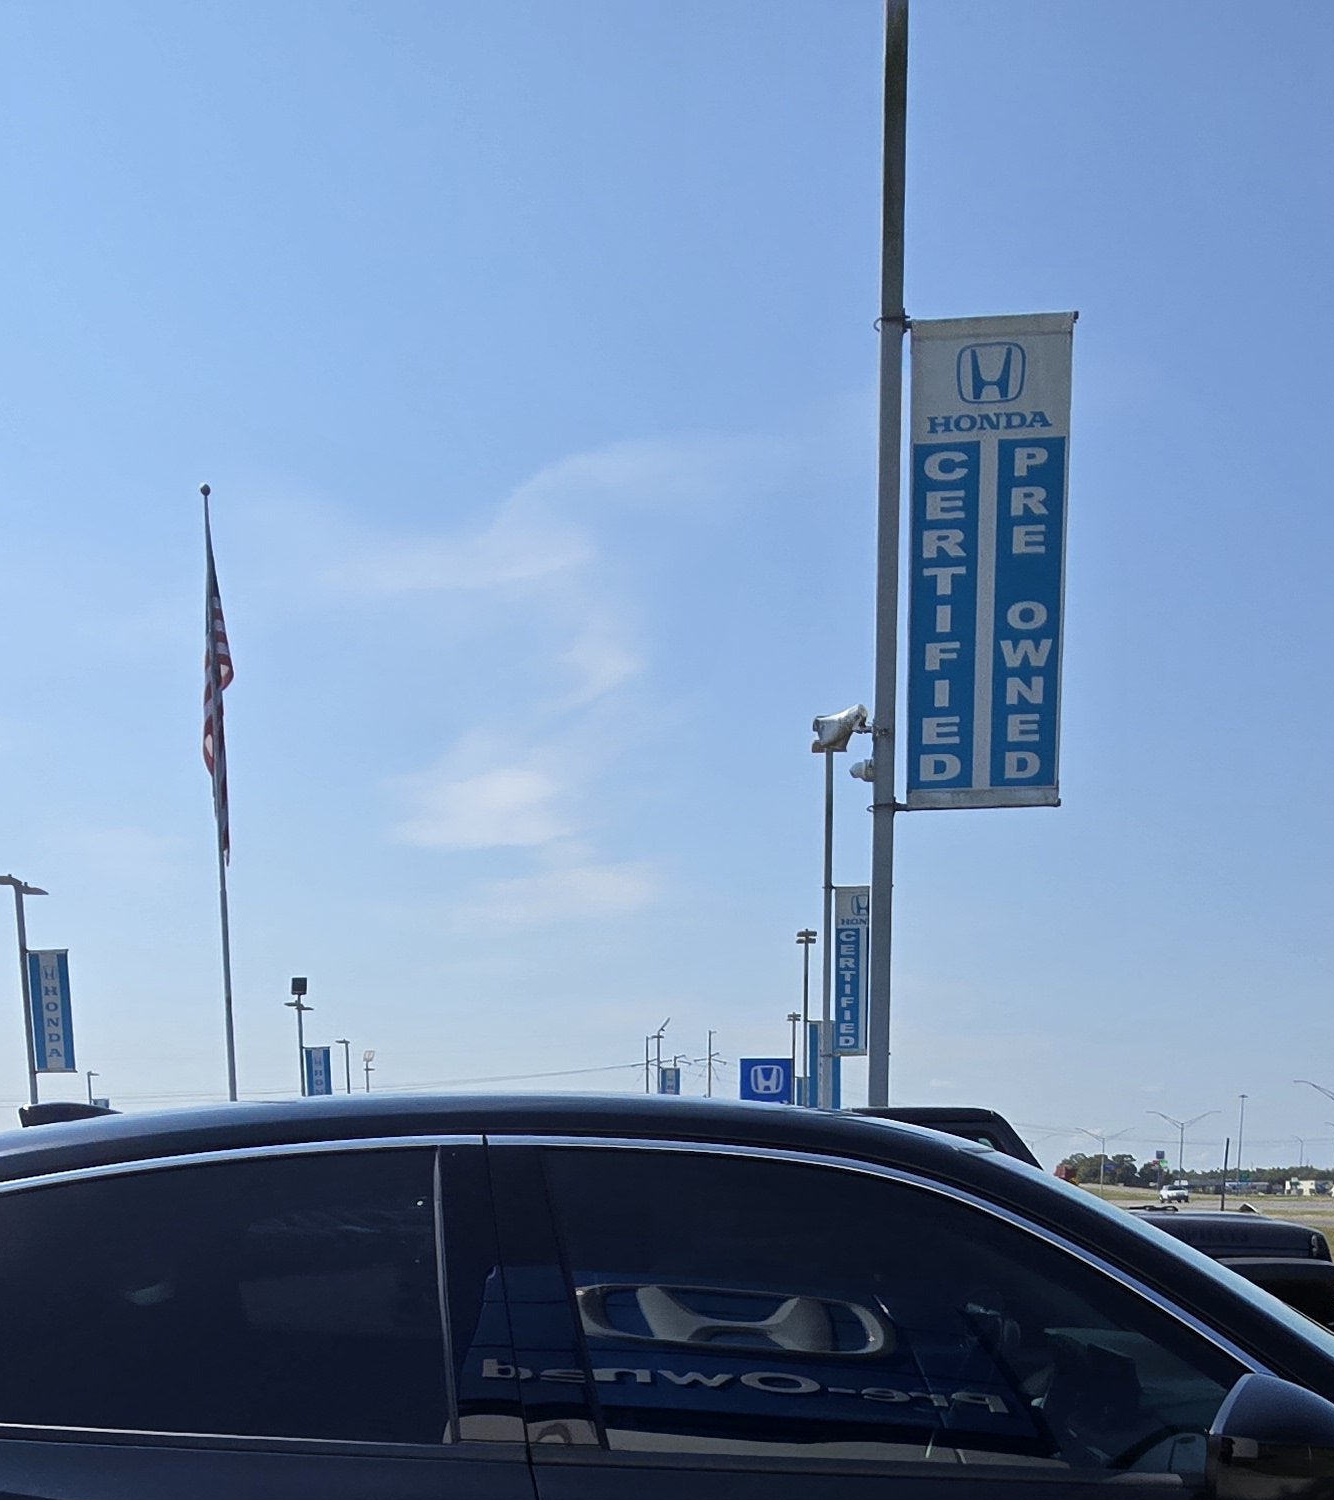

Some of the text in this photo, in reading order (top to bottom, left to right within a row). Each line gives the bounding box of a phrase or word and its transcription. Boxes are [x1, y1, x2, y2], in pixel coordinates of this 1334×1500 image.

[927, 411, 1052, 434] HONDA
[919, 451, 969, 782] CERTIFIED
[1000, 446, 1053, 780] PRE OWNED
[841, 918, 867, 926] HON
[43, 985, 63, 1058] HONDA
[839, 931, 857, 1046] CERTIFIED
[314, 1069, 324, 1095] HON
